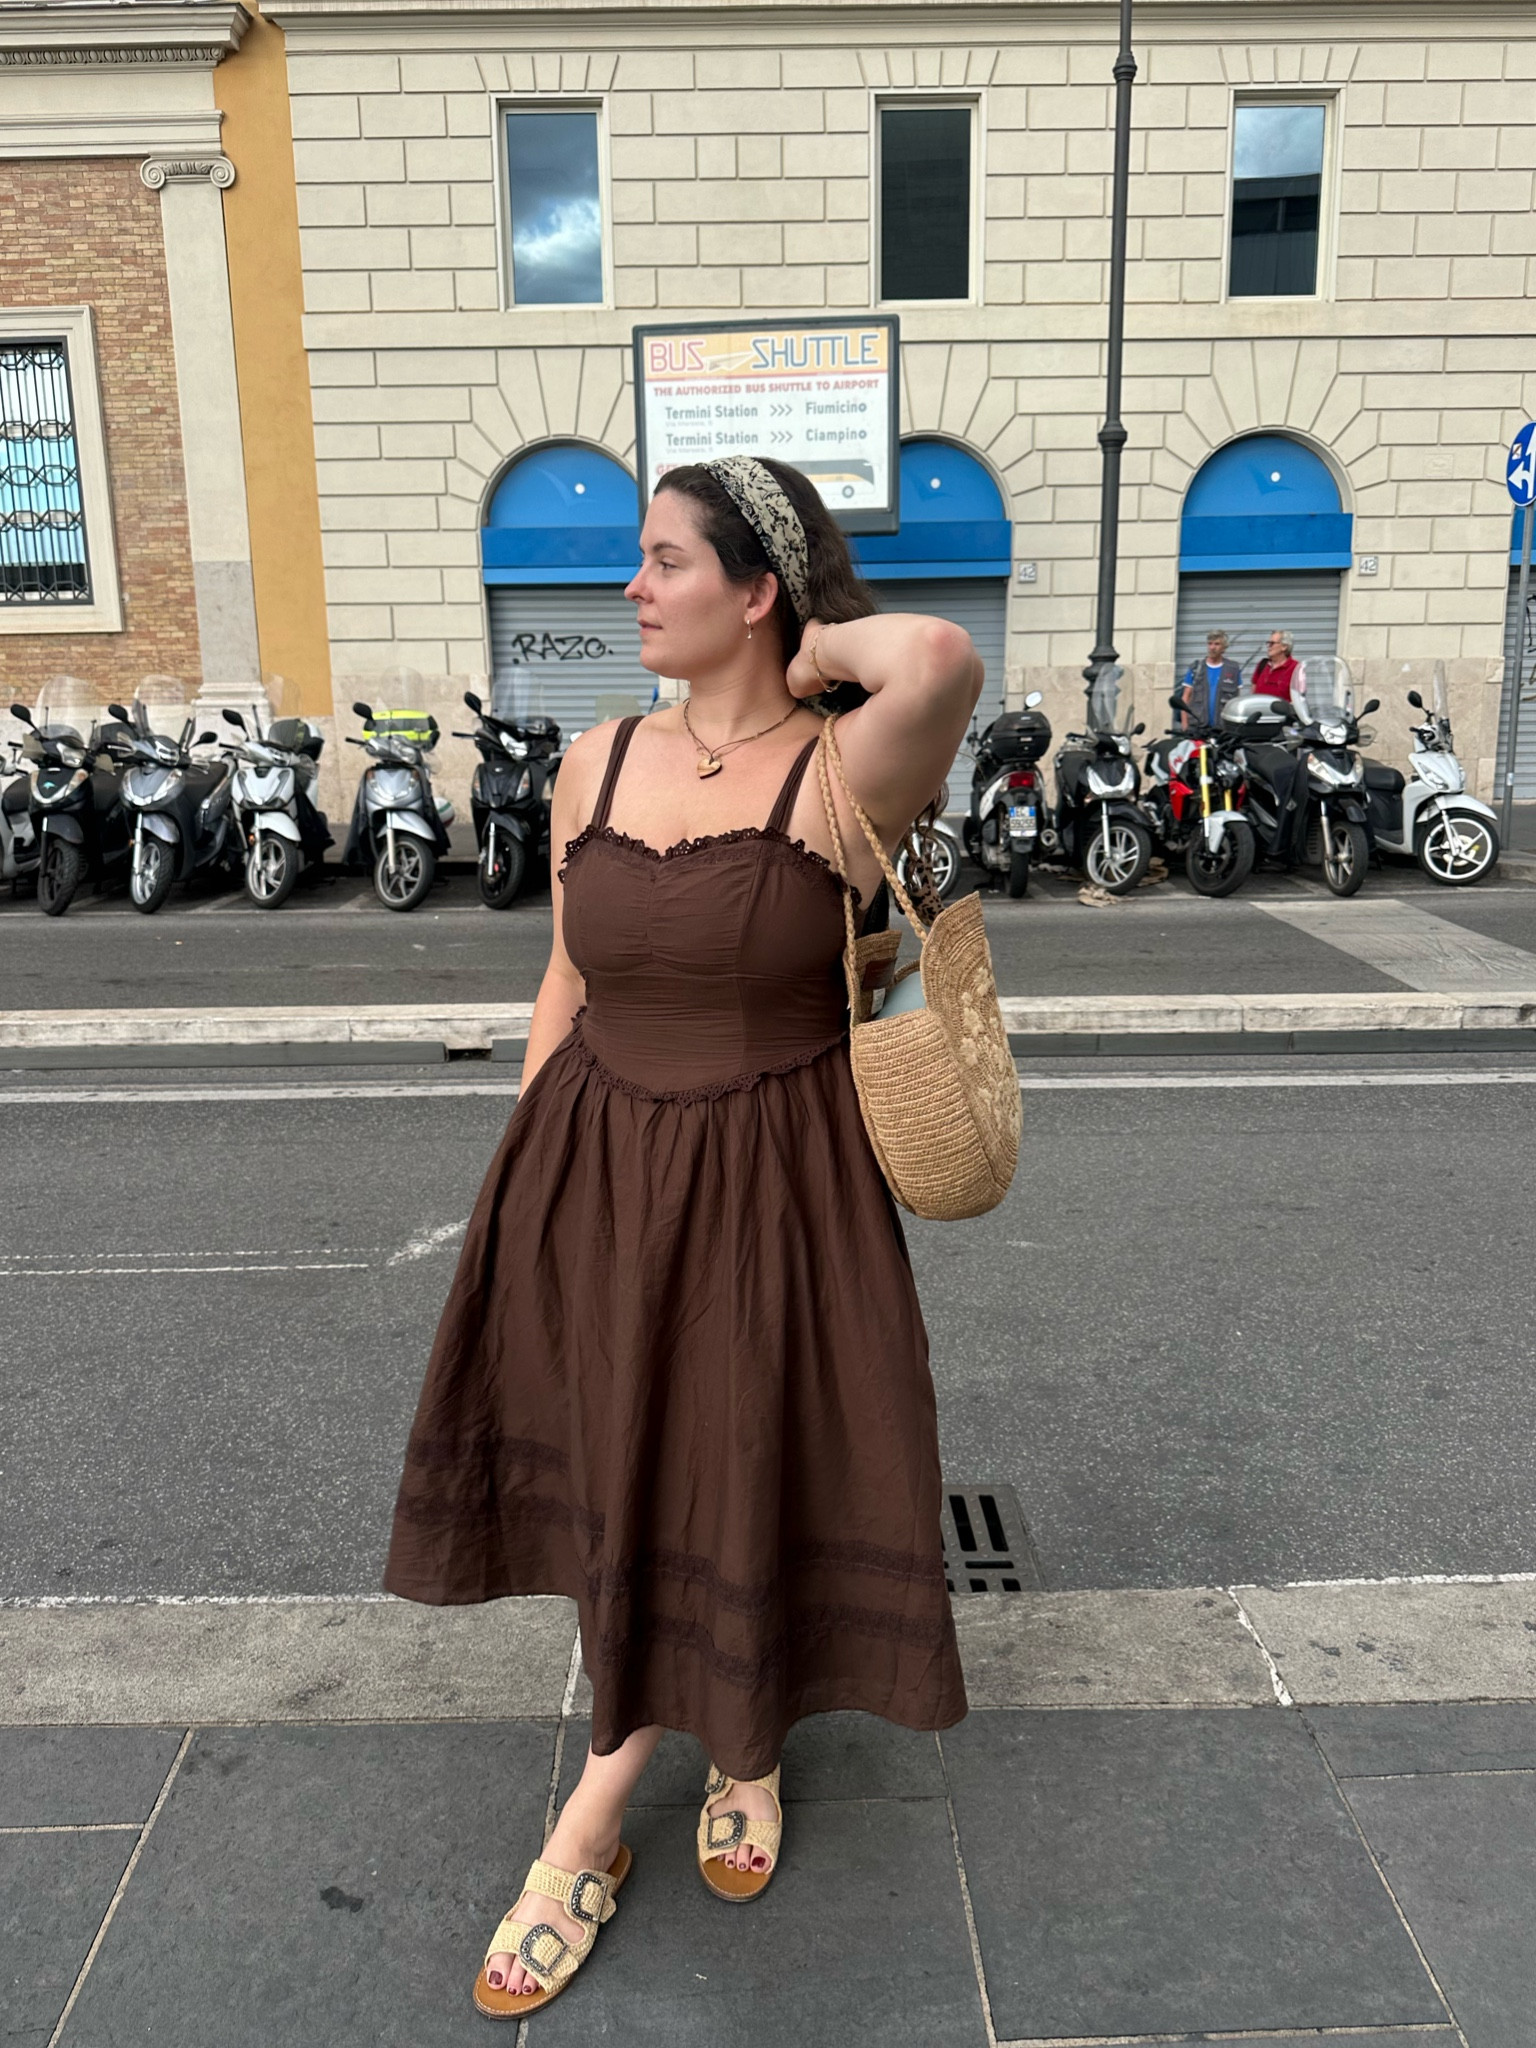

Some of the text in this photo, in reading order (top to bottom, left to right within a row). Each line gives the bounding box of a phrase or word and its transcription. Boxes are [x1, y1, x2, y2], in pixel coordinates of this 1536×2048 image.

[650, 334, 878, 372] BUS SHUTTLE
[654, 379, 879, 396] THE AUTHORIZED BUS SHUTTLE TO AIRPORT
[665, 400, 867, 419] Termini Station Fiumicino
[666, 428, 867, 446] Termini Station Ciampino
